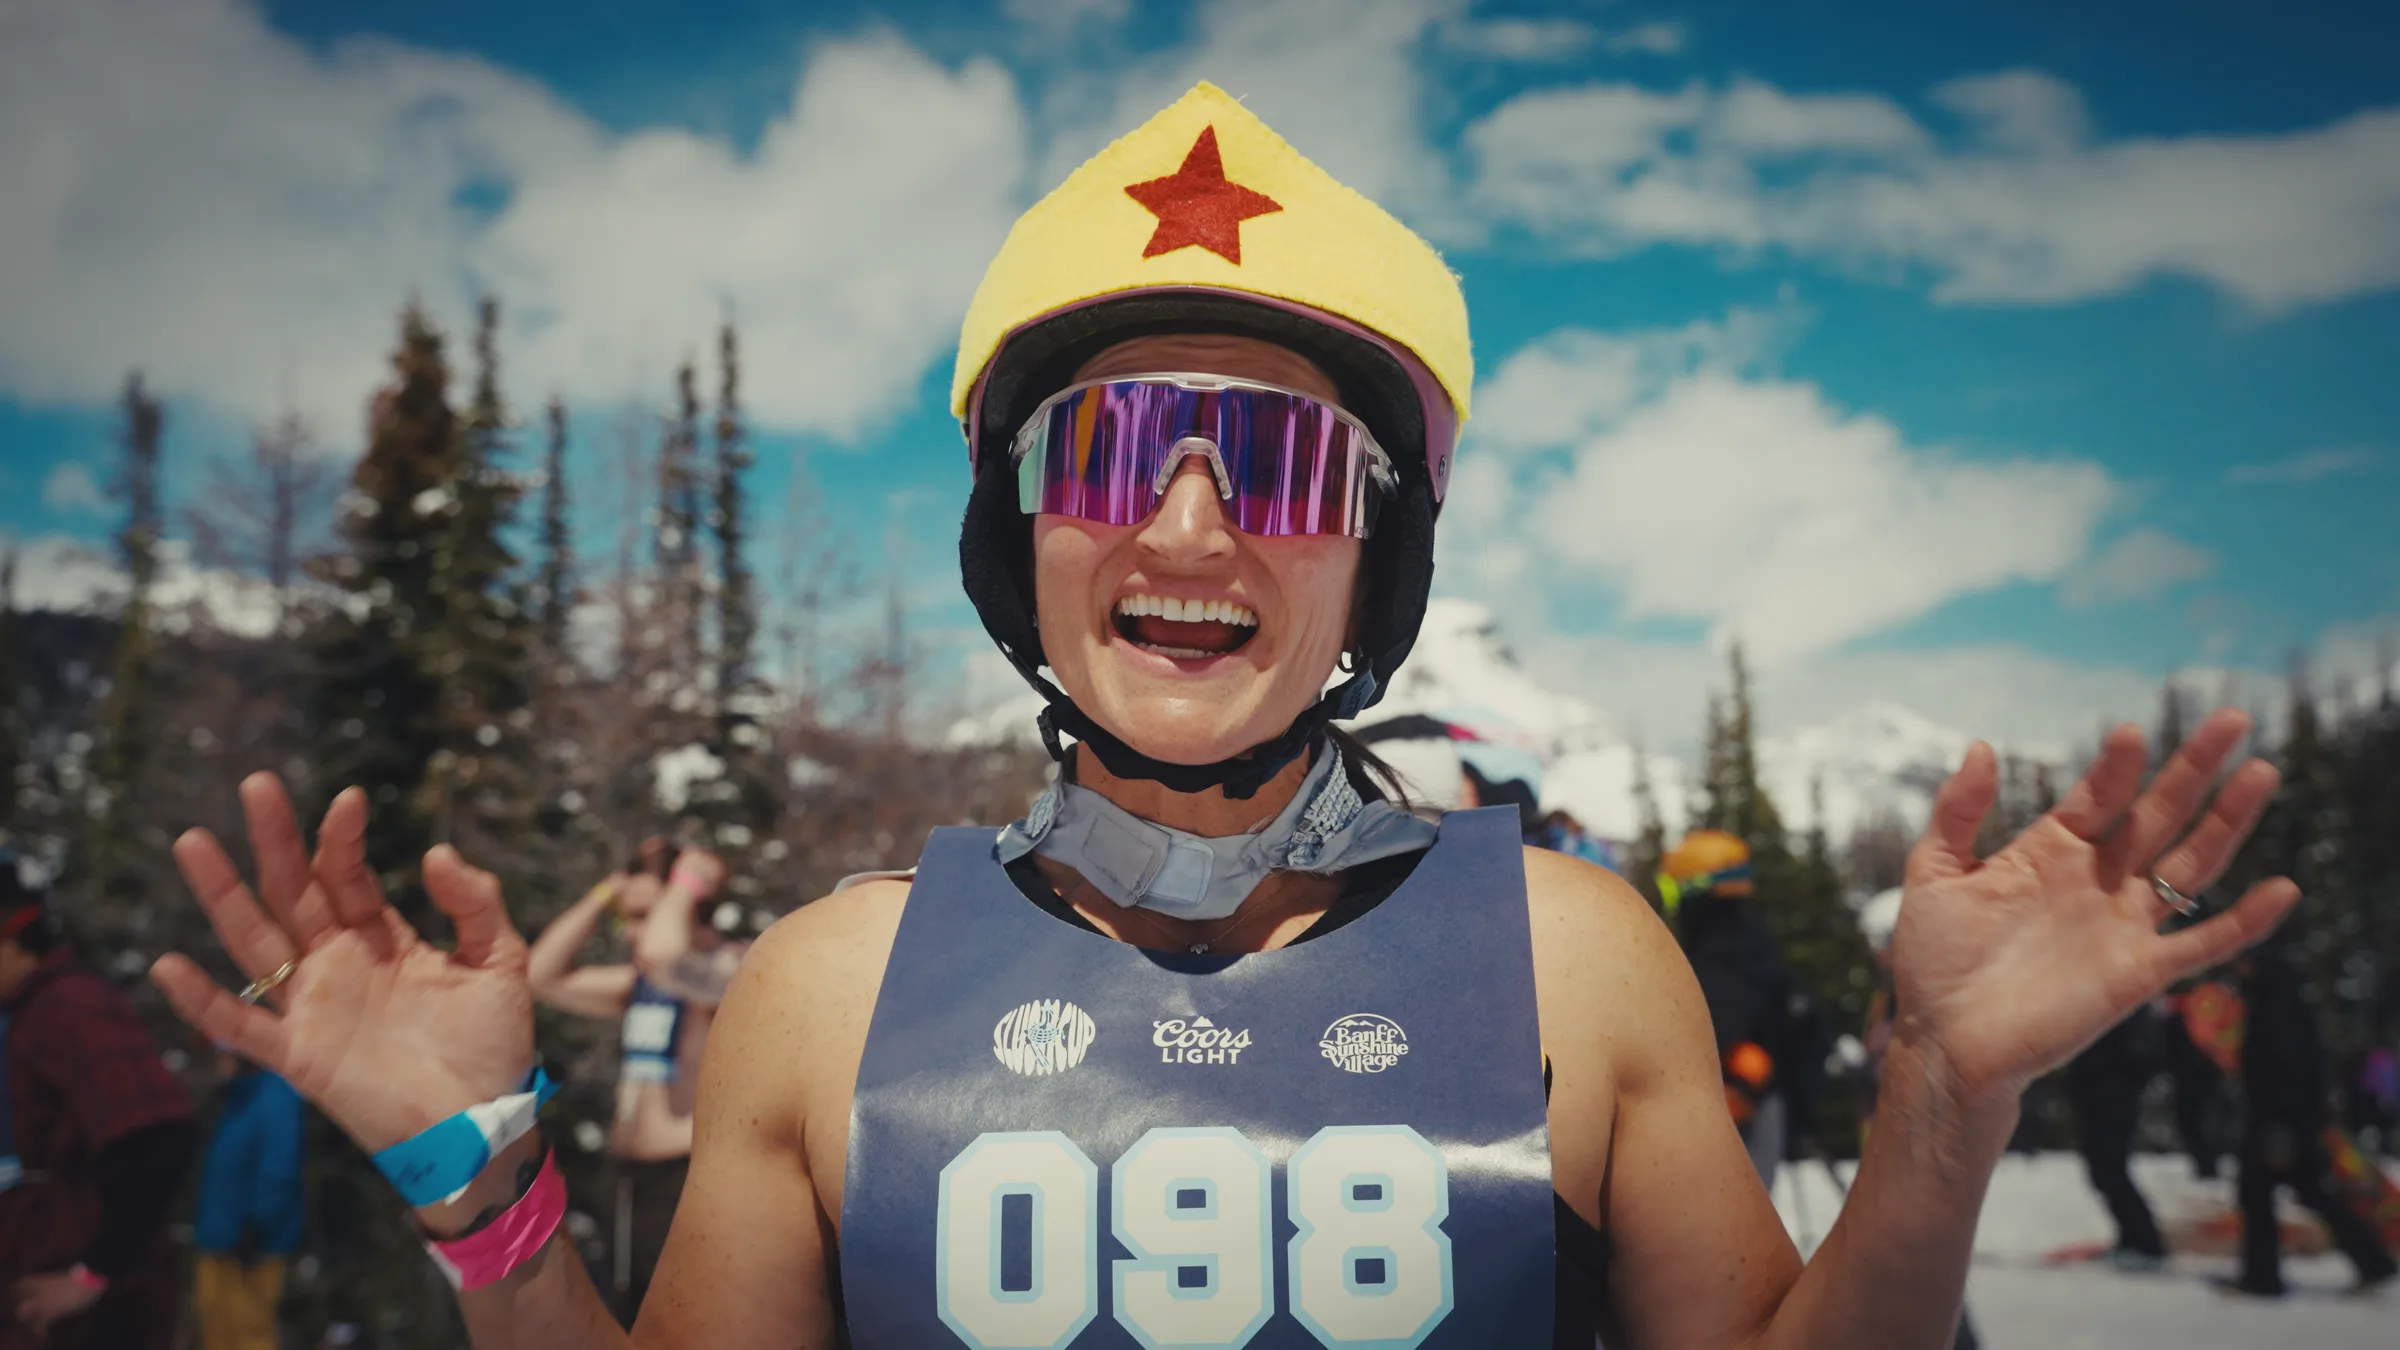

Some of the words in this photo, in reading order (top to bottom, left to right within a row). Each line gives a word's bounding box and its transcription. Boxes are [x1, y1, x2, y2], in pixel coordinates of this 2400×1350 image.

[1152, 1019, 1252, 1049] Coors
[1334, 1023, 1399, 1046] Banff
[1161, 1047, 1242, 1065] LIGHT
[1318, 1039, 1409, 1058] Sunshine
[1327, 1052, 1398, 1074] Village
[935, 1124, 1455, 1350] 098
